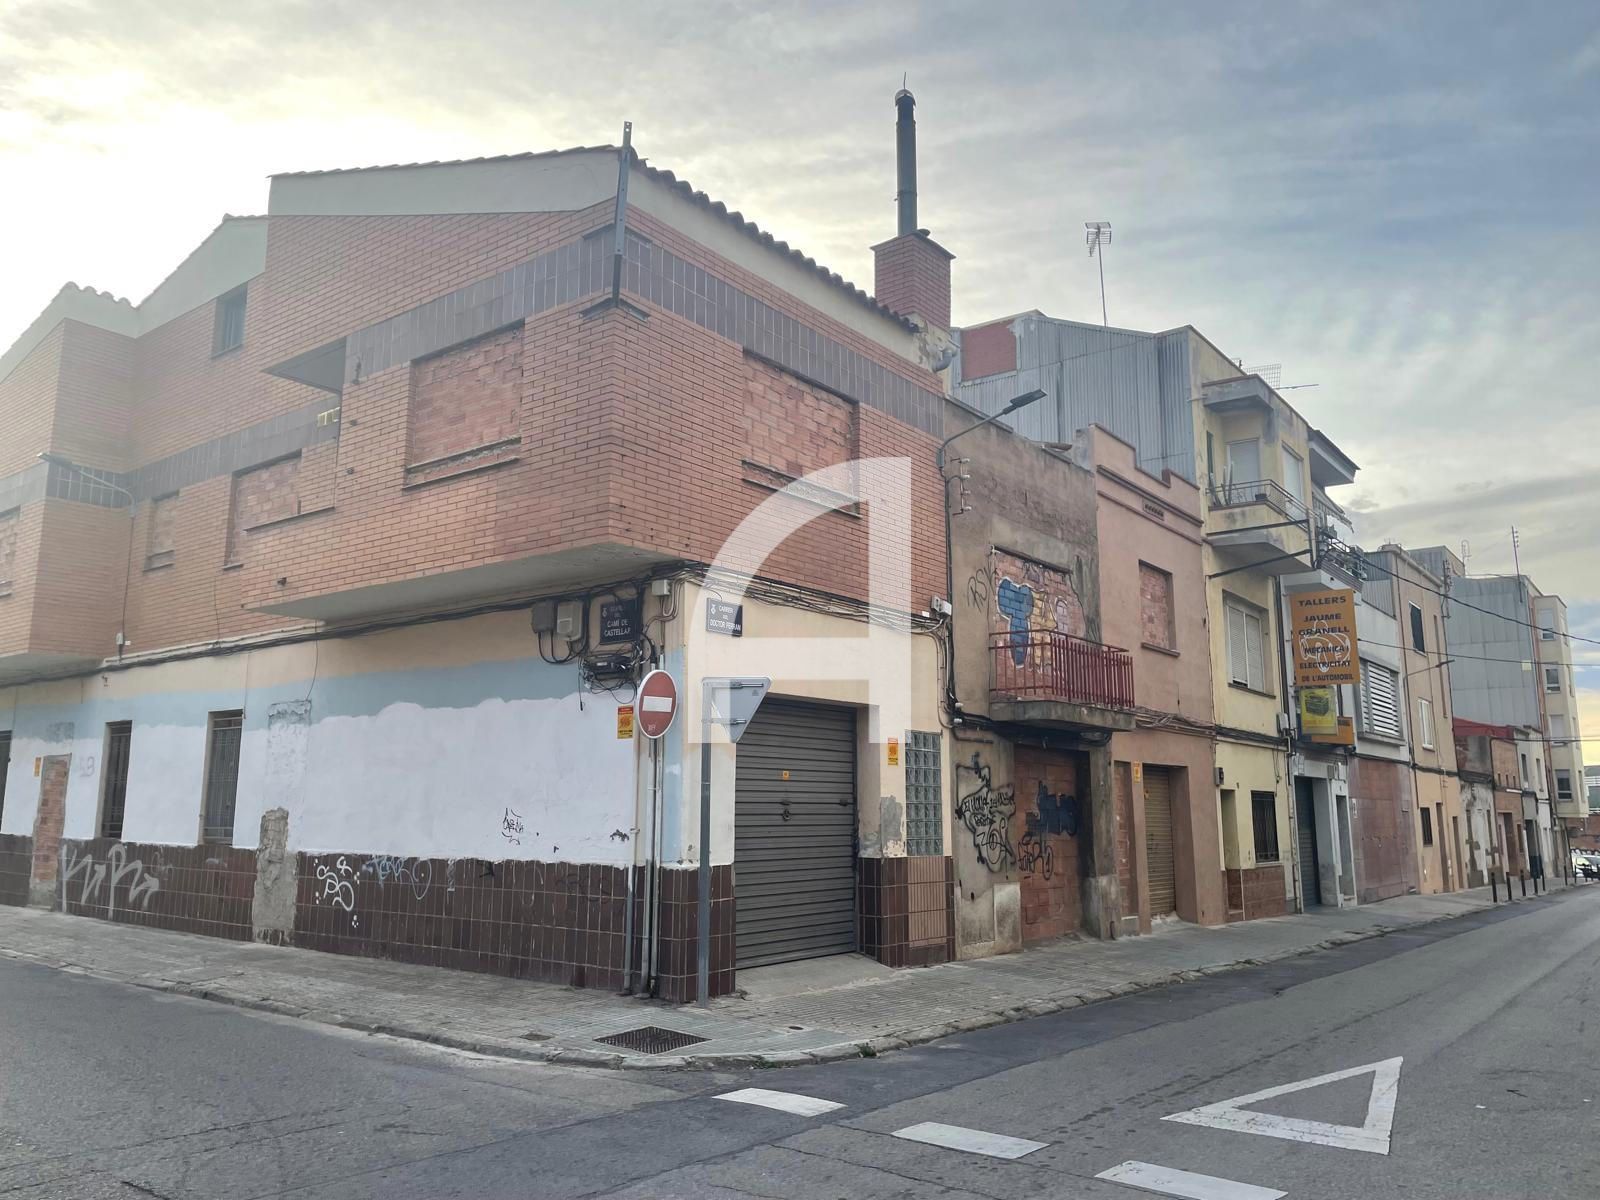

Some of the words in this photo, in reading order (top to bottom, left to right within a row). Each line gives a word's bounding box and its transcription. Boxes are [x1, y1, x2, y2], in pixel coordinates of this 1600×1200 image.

[1298, 596, 1346, 607] TALLERS
[1304, 613, 1342, 622] JAUME
[710, 619, 726, 628] DOCTOR
[1298, 626, 1350, 636] GRANELL
[1299, 660, 1351, 669] ELECTRICITAT
